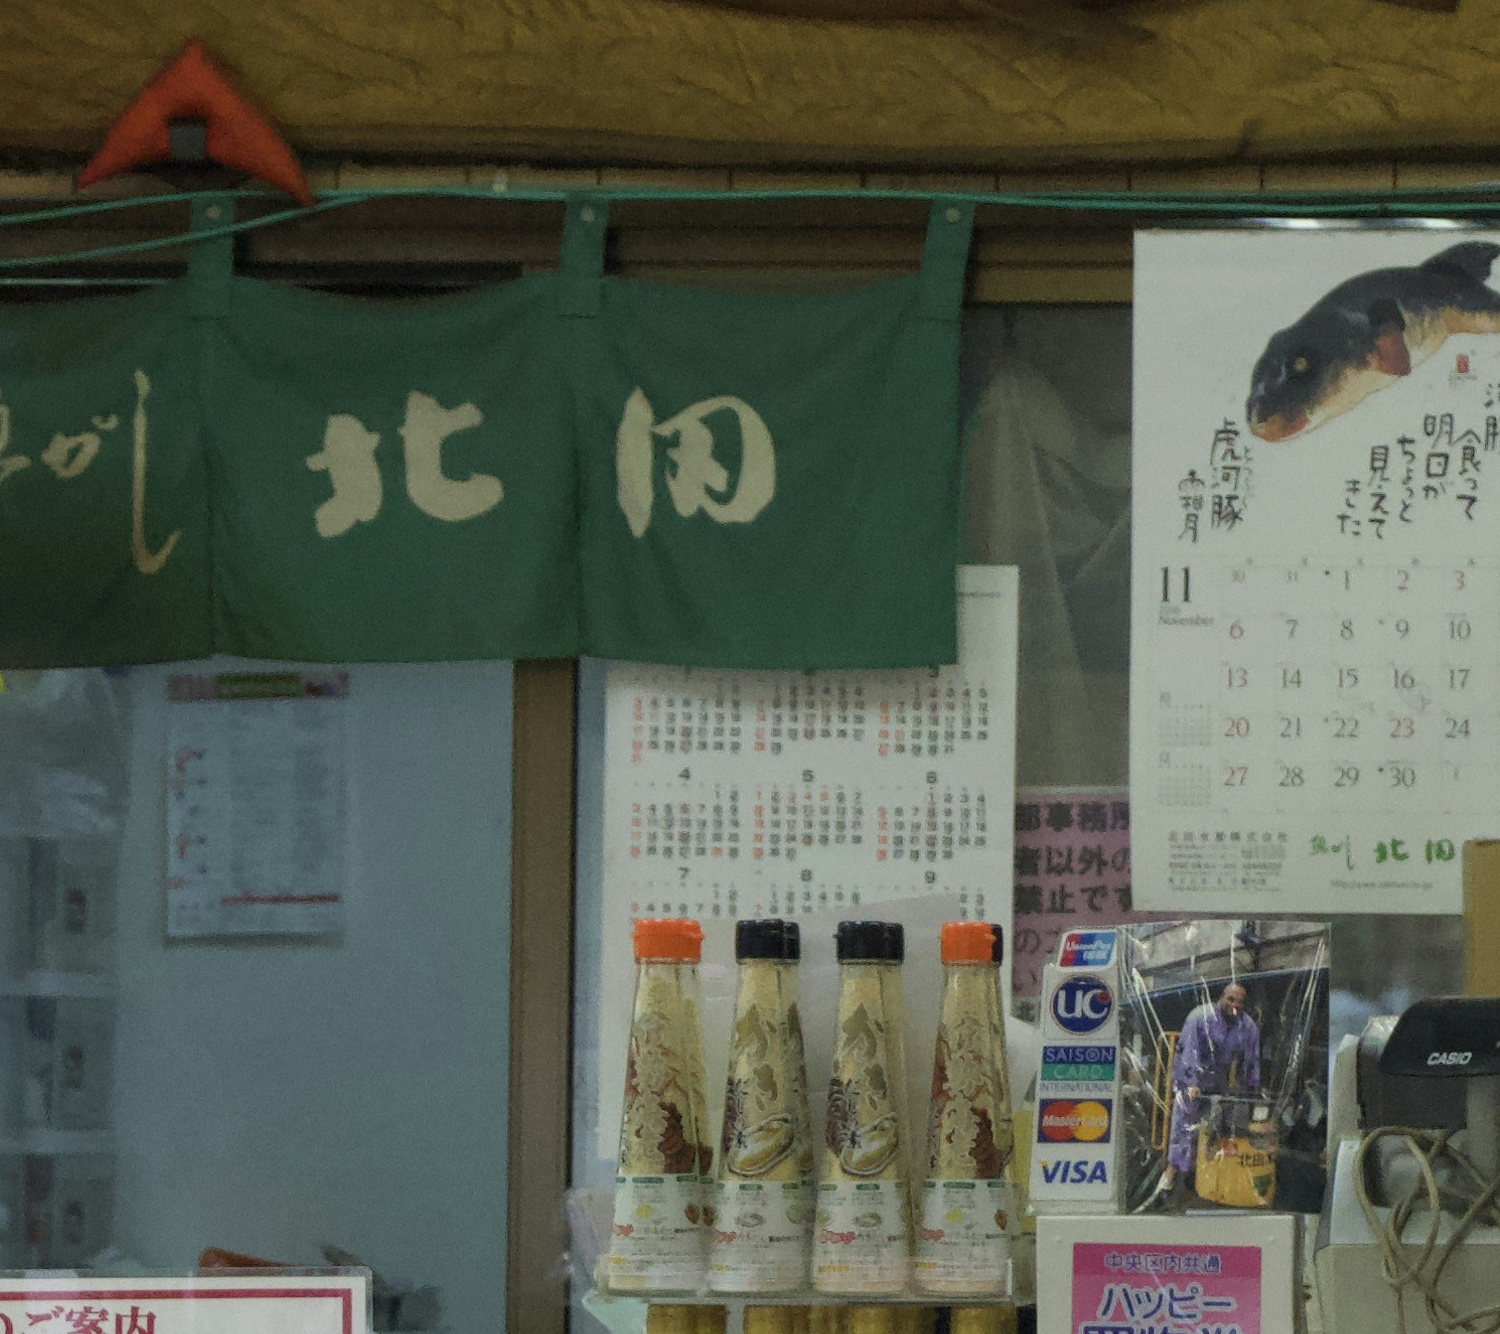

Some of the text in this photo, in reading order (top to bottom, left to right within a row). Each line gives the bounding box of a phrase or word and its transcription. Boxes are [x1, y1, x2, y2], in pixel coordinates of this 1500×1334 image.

[1423, 413, 1456, 501] 明日が
[1210, 417, 1244, 532] 虎河豚
[1453, 430, 1483, 521] 食って
[1159, 566, 1192, 603] 11
[1396, 570, 1411, 590] 2
[1455, 570, 1466, 590] 3
[1229, 620, 1244, 641] 6
[1286, 620, 1298, 641] 7
[1340, 620, 1354, 641] 8
[1395, 620, 1410, 641] 9
[1448, 620, 1471, 641] 10
[1227, 667, 1248, 689] 13
[1281, 667, 1301, 689] 14
[1337, 667, 1358, 689] 15
[1393, 667, 1415, 689] 16
[1448, 667, 1470, 689] 17
[1224, 717, 1250, 739] 20
[1280, 717, 1301, 739] 21
[1334, 717, 1359, 739] 22
[1389, 717, 1415, 739] 23
[1445, 717, 1471, 739] 24
[1223, 766, 1248, 788] 27
[1279, 766, 1304, 788] 28
[1334, 766, 1359, 788] 29
[1390, 766, 1416, 788] 30
[1056, 987, 1110, 1020] UC
[1044, 1047, 1114, 1064] SAISON
[1426, 1051, 1473, 1066] CASIO
[1040, 1081, 1113, 1094] INTERNATIONAL
[1041, 1114, 1110, 1128] MasterCard
[1040, 1159, 1108, 1184] VISA
[1105, 1252, 1221, 1273] 中央区内共通
[1100, 1285, 1233, 1320] ハッピー
